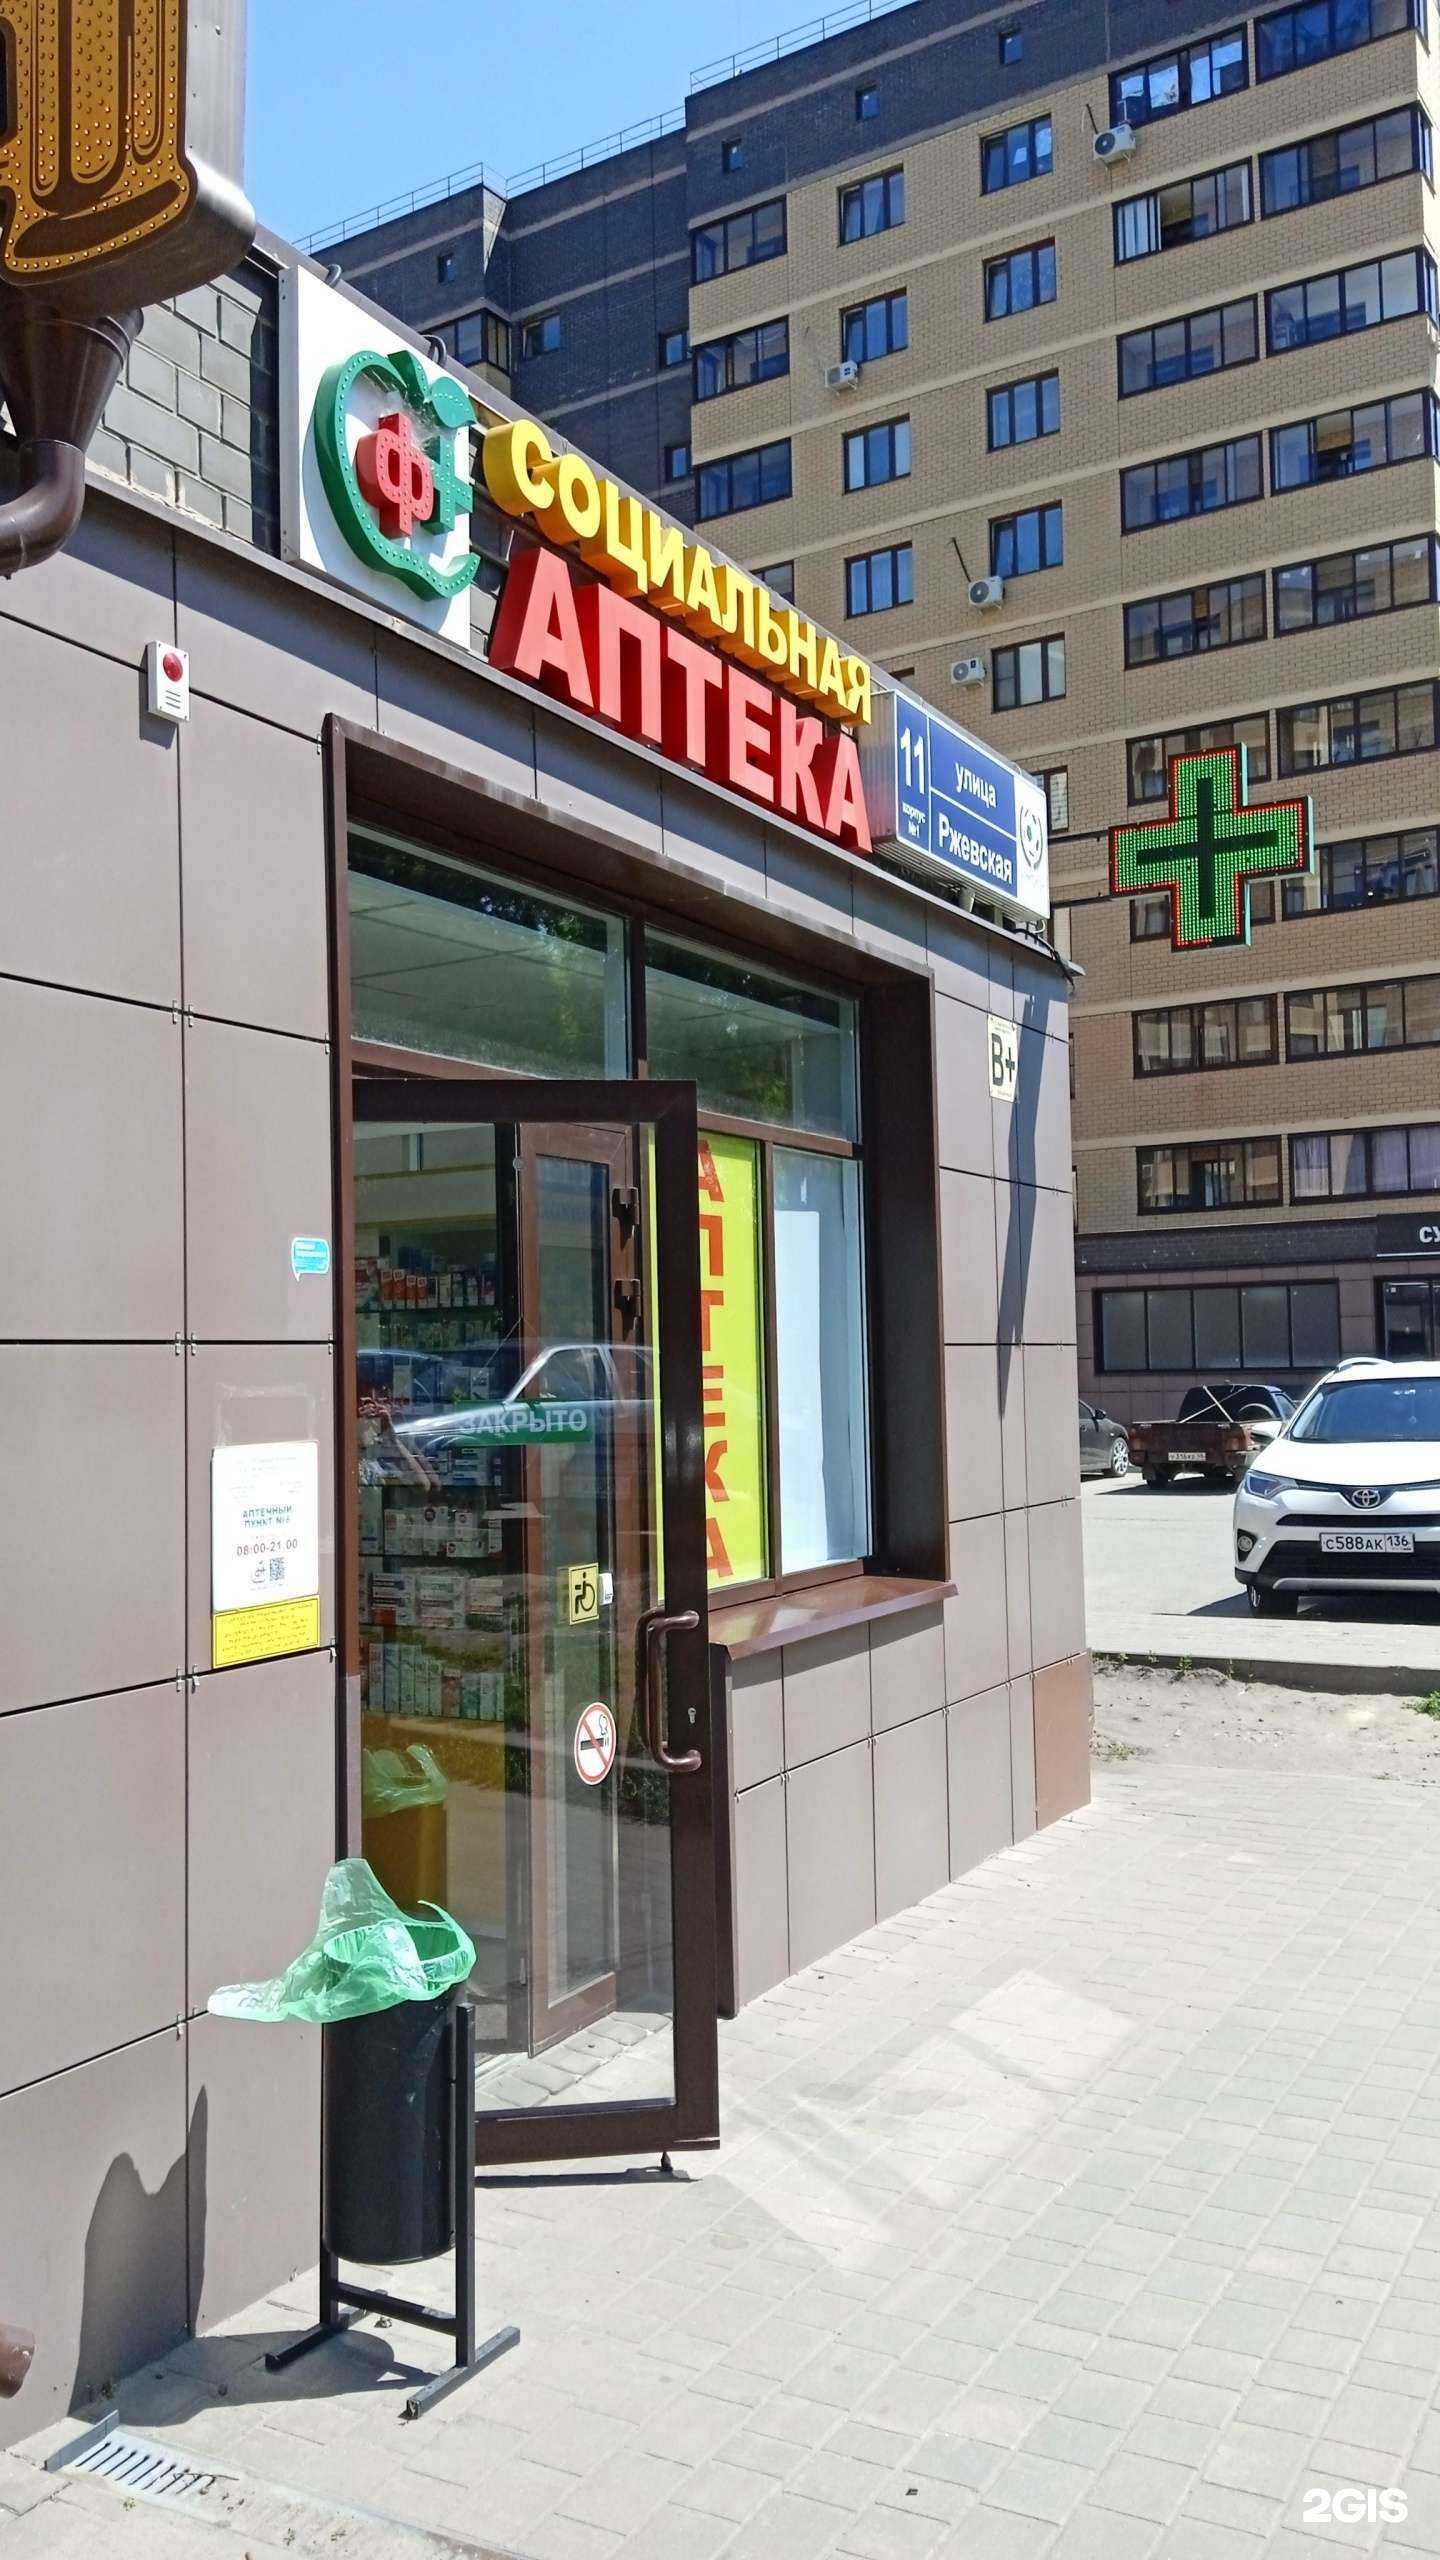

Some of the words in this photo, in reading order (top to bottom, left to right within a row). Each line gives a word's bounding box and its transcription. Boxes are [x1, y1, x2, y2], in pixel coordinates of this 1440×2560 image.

[490, 418, 871, 726] СОЦИАЛЬНАЯ
[495, 546, 873, 854] АПТЕКА
[900, 727, 925, 794] 11
[954, 761, 997, 808] улица
[937, 812, 1013, 885] Ржевская
[458, 1407, 588, 1434] ЗАКРЫТО
[1386, 1535, 1409, 1547] 136
